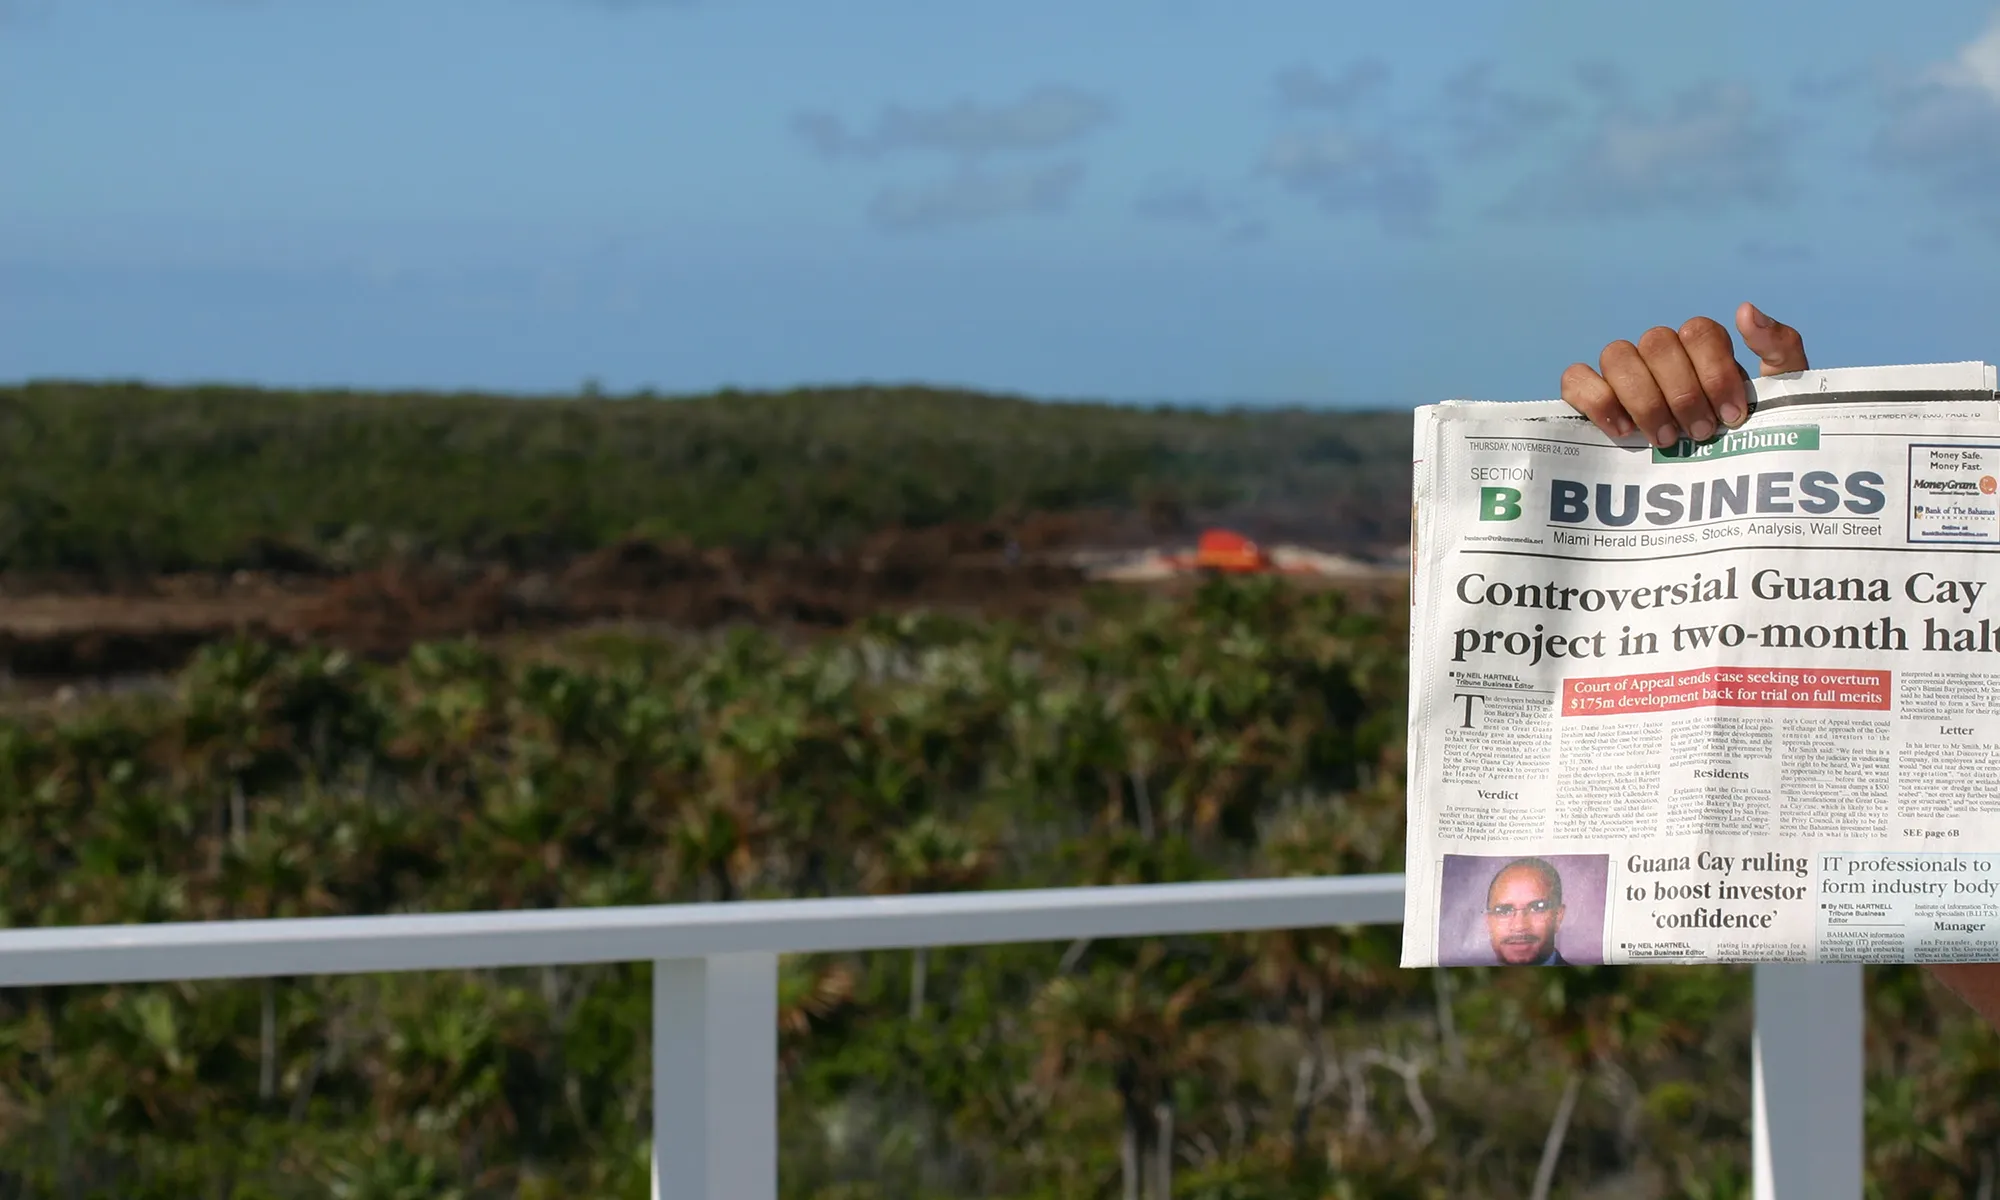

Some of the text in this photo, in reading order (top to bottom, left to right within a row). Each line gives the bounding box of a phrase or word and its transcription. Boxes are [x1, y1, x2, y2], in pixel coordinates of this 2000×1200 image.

[1470, 442, 1580, 456] THURSDAY, NOVEMBER 24, 2005
[1721, 430, 1798, 453] Tribune
[1930, 451, 1959, 461] Money
[1470, 468, 1534, 480] SECTION
[1930, 462, 1959, 471] Money
[1479, 487, 1522, 521] B
[1550, 470, 1886, 527] BUSINESS
[1553, 522, 1882, 548] Miami Herald Business, Stocks, Analysis, Wall Street
[1456, 567, 1987, 614] Controversial Guana Cay
[1451, 624, 1606, 667] project
[1618, 625, 1659, 656] in
[1672, 617, 1909, 651] two-month
[1574, 671, 1880, 695] Court of Appeal sends case seeking to overturn
[1493, 696, 1523, 704] developers
[1570, 688, 1882, 711] $175m development back for trial on full merits
[1940, 725, 1974, 735] Letter
[1694, 769, 1749, 779] Residents
[1477, 790, 1519, 800] Verdict
[1947, 829, 1960, 837] 6B
[1627, 851, 1809, 878] Guana Cay ruling
[1822, 856, 1992, 875] IT professionals to
[1626, 880, 1807, 901] to boost investor
[1822, 879, 1999, 898] form industry body
[1934, 921, 1986, 933] Manager
